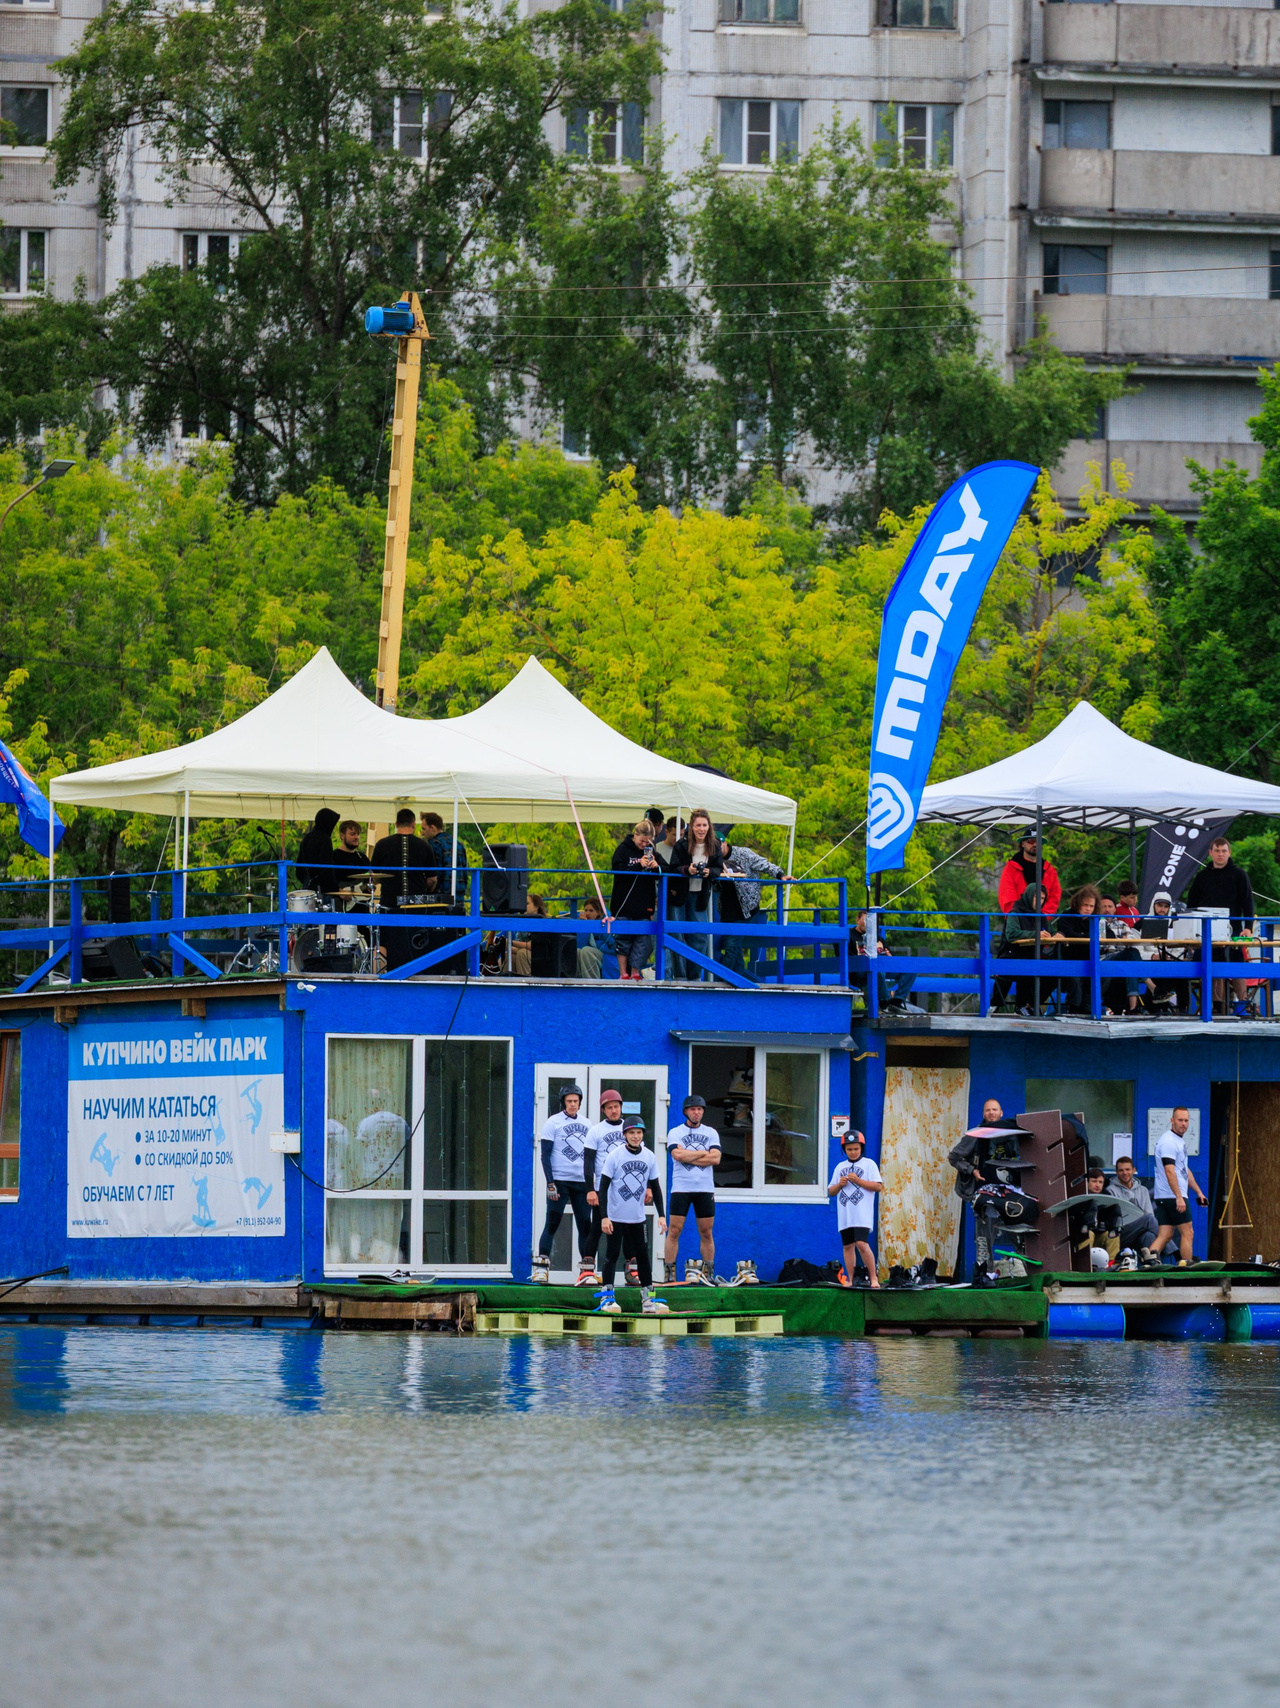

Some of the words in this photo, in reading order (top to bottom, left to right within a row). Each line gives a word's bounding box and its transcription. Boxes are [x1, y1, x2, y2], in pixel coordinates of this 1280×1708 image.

[1158, 844, 1187, 888] ZONE
[82, 1039, 167, 1066] КУПЧИНО
[169, 1031, 217, 1063] ВЕЙК
[219, 1036, 268, 1062] ПАРК
[83, 1097, 145, 1120] НАУЧИМ
[148, 1095, 216, 1119] КАТАТЬСЯ
[144, 1130, 155, 1143] ЗА
[157, 1129, 180, 1143] 10-20
[181, 1128, 212, 1142] МИНУТ
[144, 1152, 156, 1166] СО
[157, 1149, 199, 1168] СКИДКОЙ
[199, 1151, 213, 1168] ДО
[215, 1151, 233, 1165] 50%
[82, 1185, 135, 1203] ОБУЧАЕМ
[137, 1185, 145, 1201] С
[147, 1185, 152, 1201] 7
[154, 1184, 175, 1201] ЛЕТ
